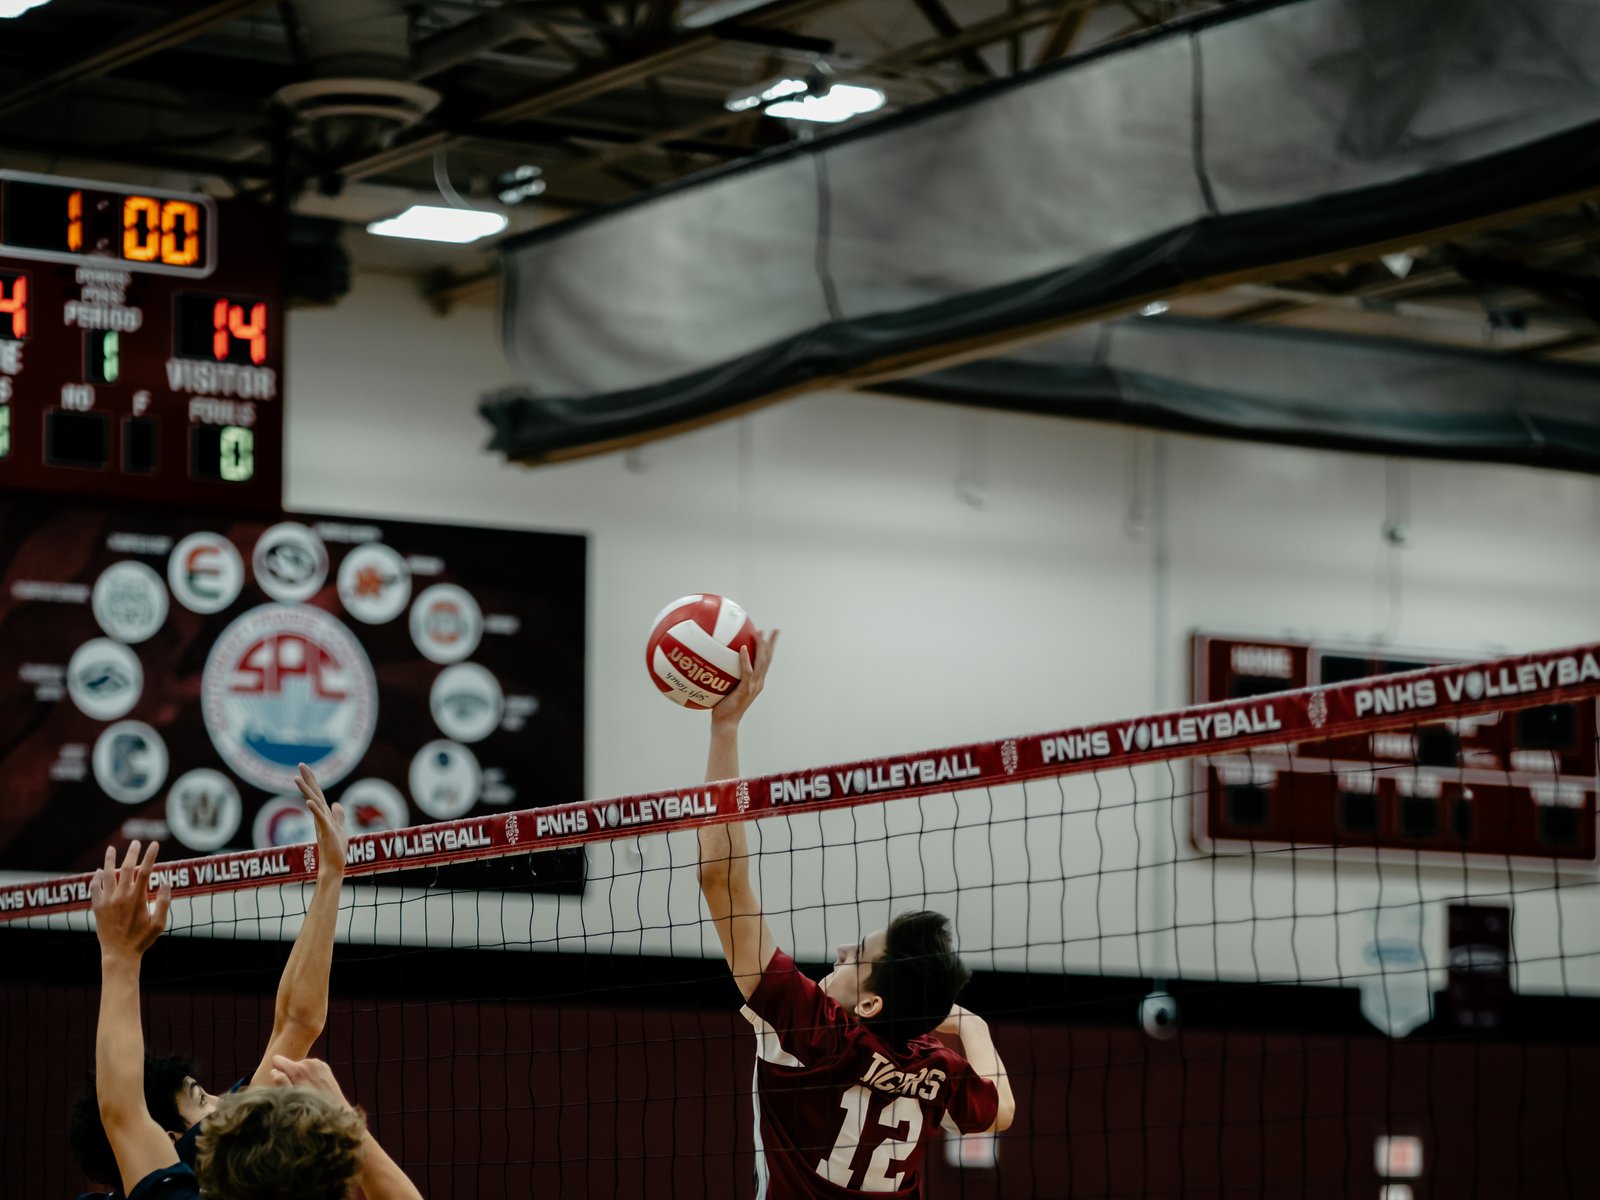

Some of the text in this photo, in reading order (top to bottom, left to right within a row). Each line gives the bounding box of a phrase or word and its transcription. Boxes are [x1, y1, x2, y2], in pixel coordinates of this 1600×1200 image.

[63, 301, 143, 333] PERIOD
[213, 298, 267, 365] 14
[103, 330, 119, 383] 1
[166, 357, 276, 400] VISITOR
[220, 425, 254, 482] 0
[666, 672, 709, 702] Soft Touch
[667, 646, 730, 692] molten
[1354, 679, 1437, 717] PNHS
[1040, 731, 1111, 764] PNHS
[1117, 705, 1282, 751] VOLLEYBALL
[770, 753, 981, 805] PNHS VOLLEYBALL
[536, 791, 717, 837] PNHS VOLLEYBALL
[345, 824, 491, 865] NHS VOLLEYBALL
[193, 854, 290, 885] VOLLEYBALL
[815, 1085, 923, 1192] 12
